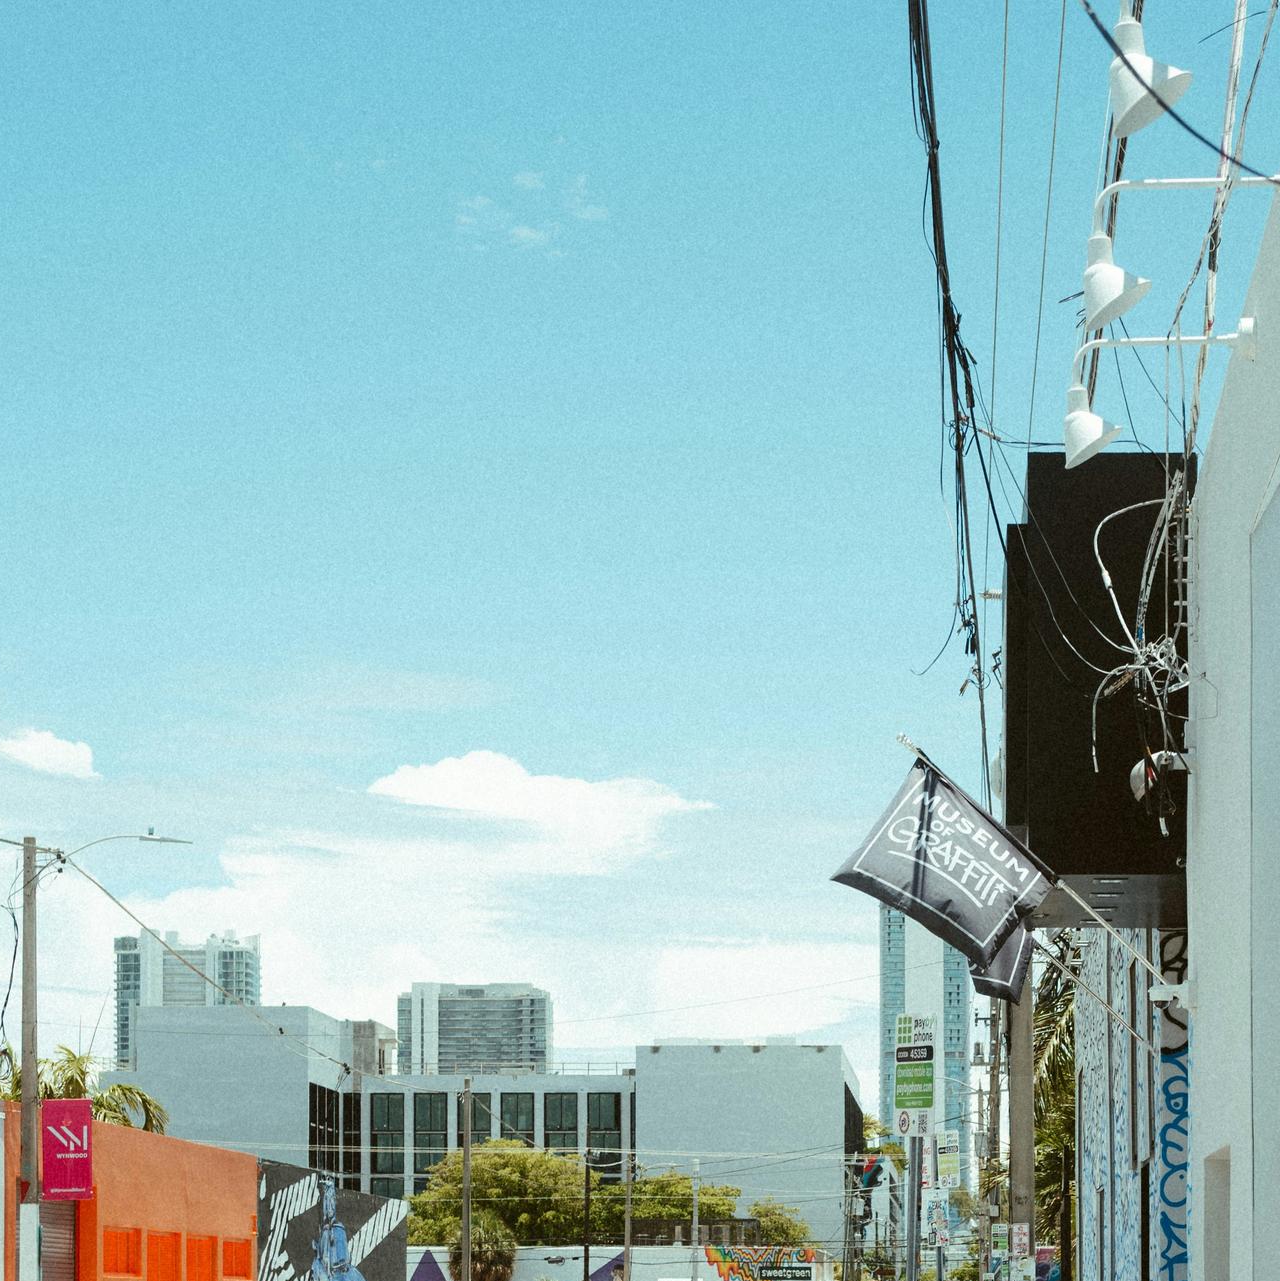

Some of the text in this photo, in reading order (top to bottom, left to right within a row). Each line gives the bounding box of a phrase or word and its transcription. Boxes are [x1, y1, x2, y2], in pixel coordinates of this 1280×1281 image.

[912, 791, 1032, 882] MUSEUM
[931, 819, 955, 838] OF
[913, 1031, 934, 1045] phone
[761, 1268, 811, 1279] sweetgreen
